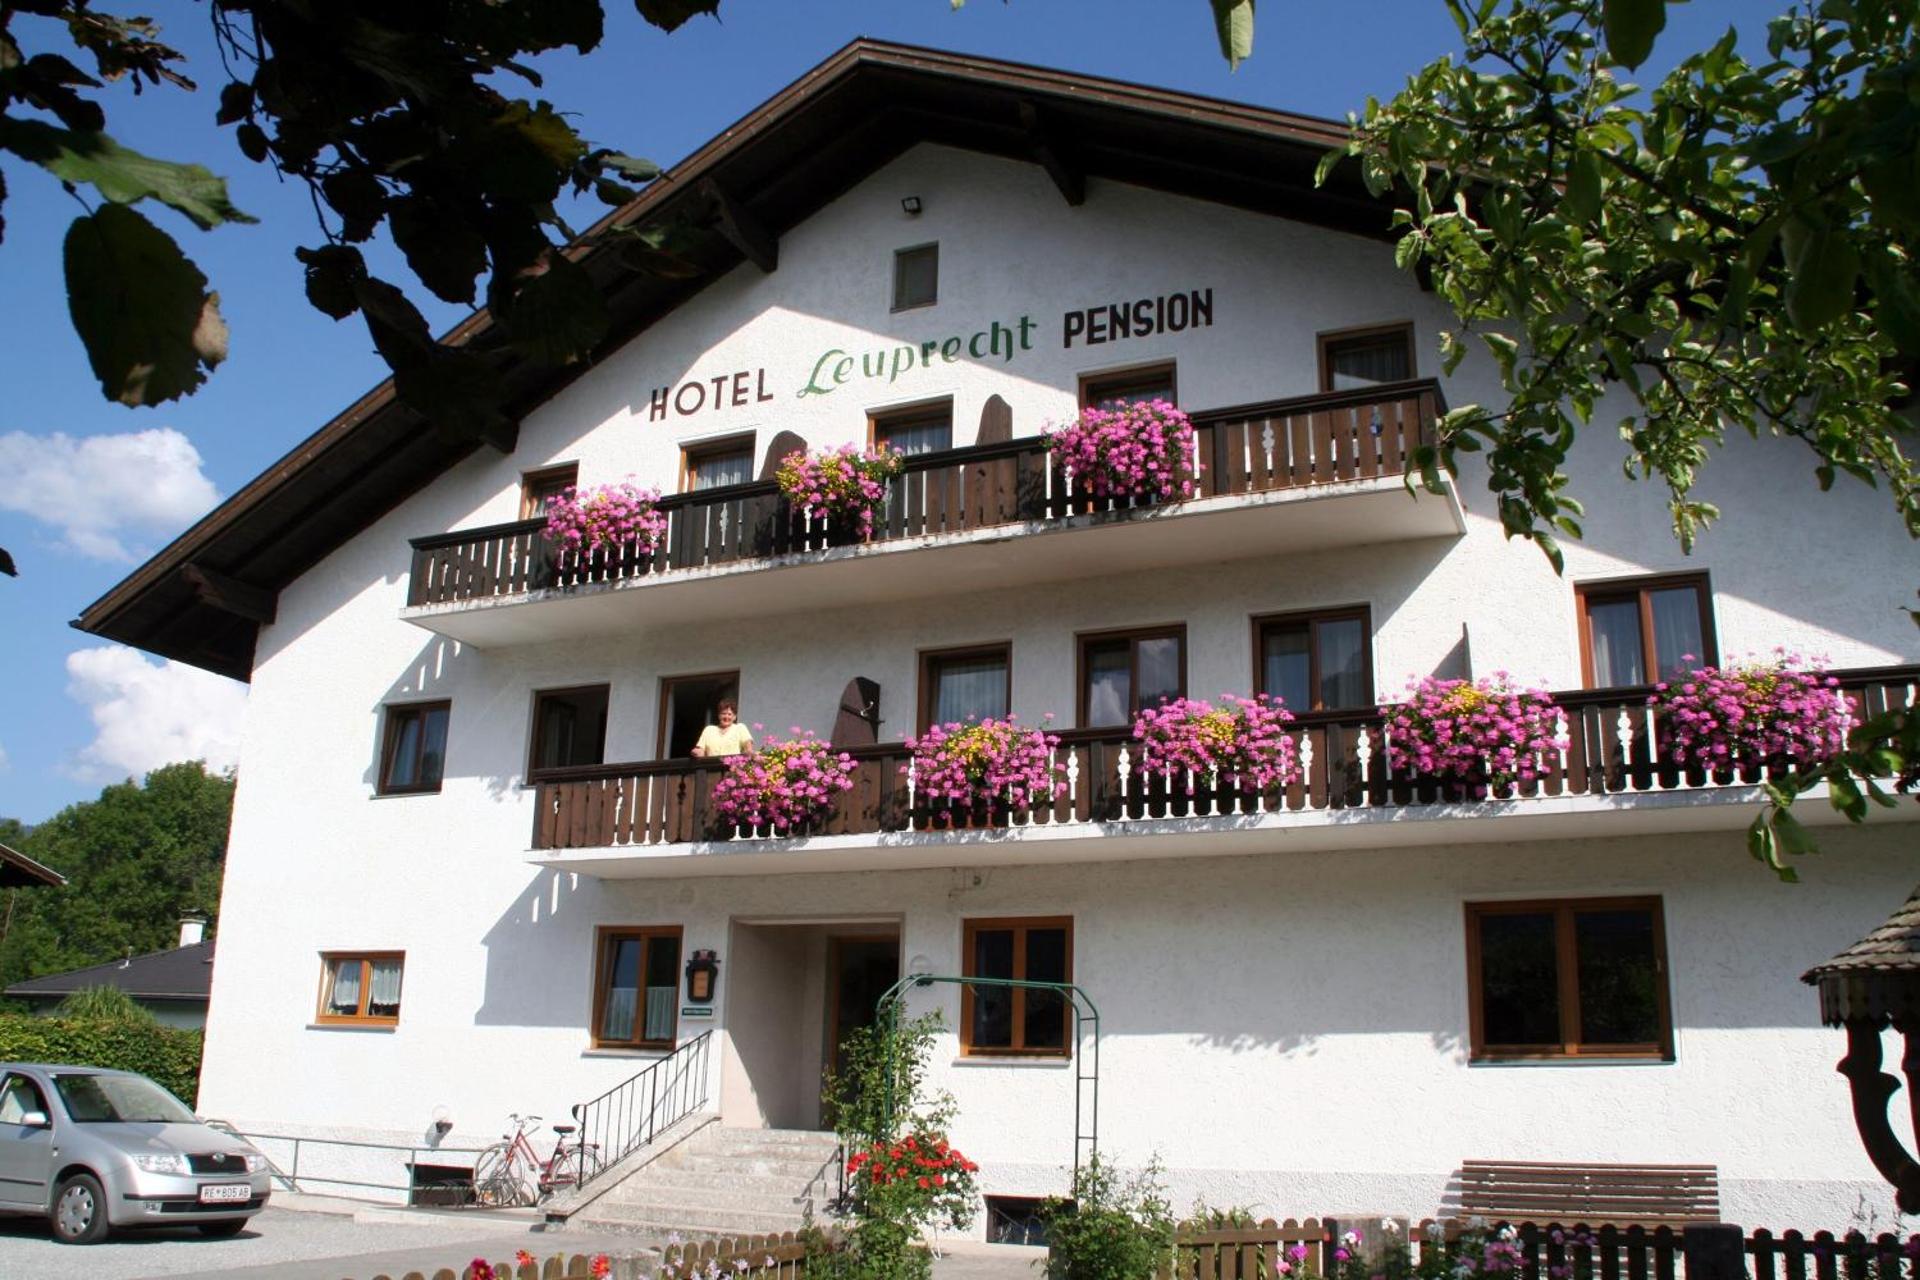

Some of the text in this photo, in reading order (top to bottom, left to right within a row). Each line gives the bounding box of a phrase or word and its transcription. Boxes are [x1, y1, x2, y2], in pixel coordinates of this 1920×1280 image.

[649, 288, 1213, 422] HOTEL Leuprecht PENSION
